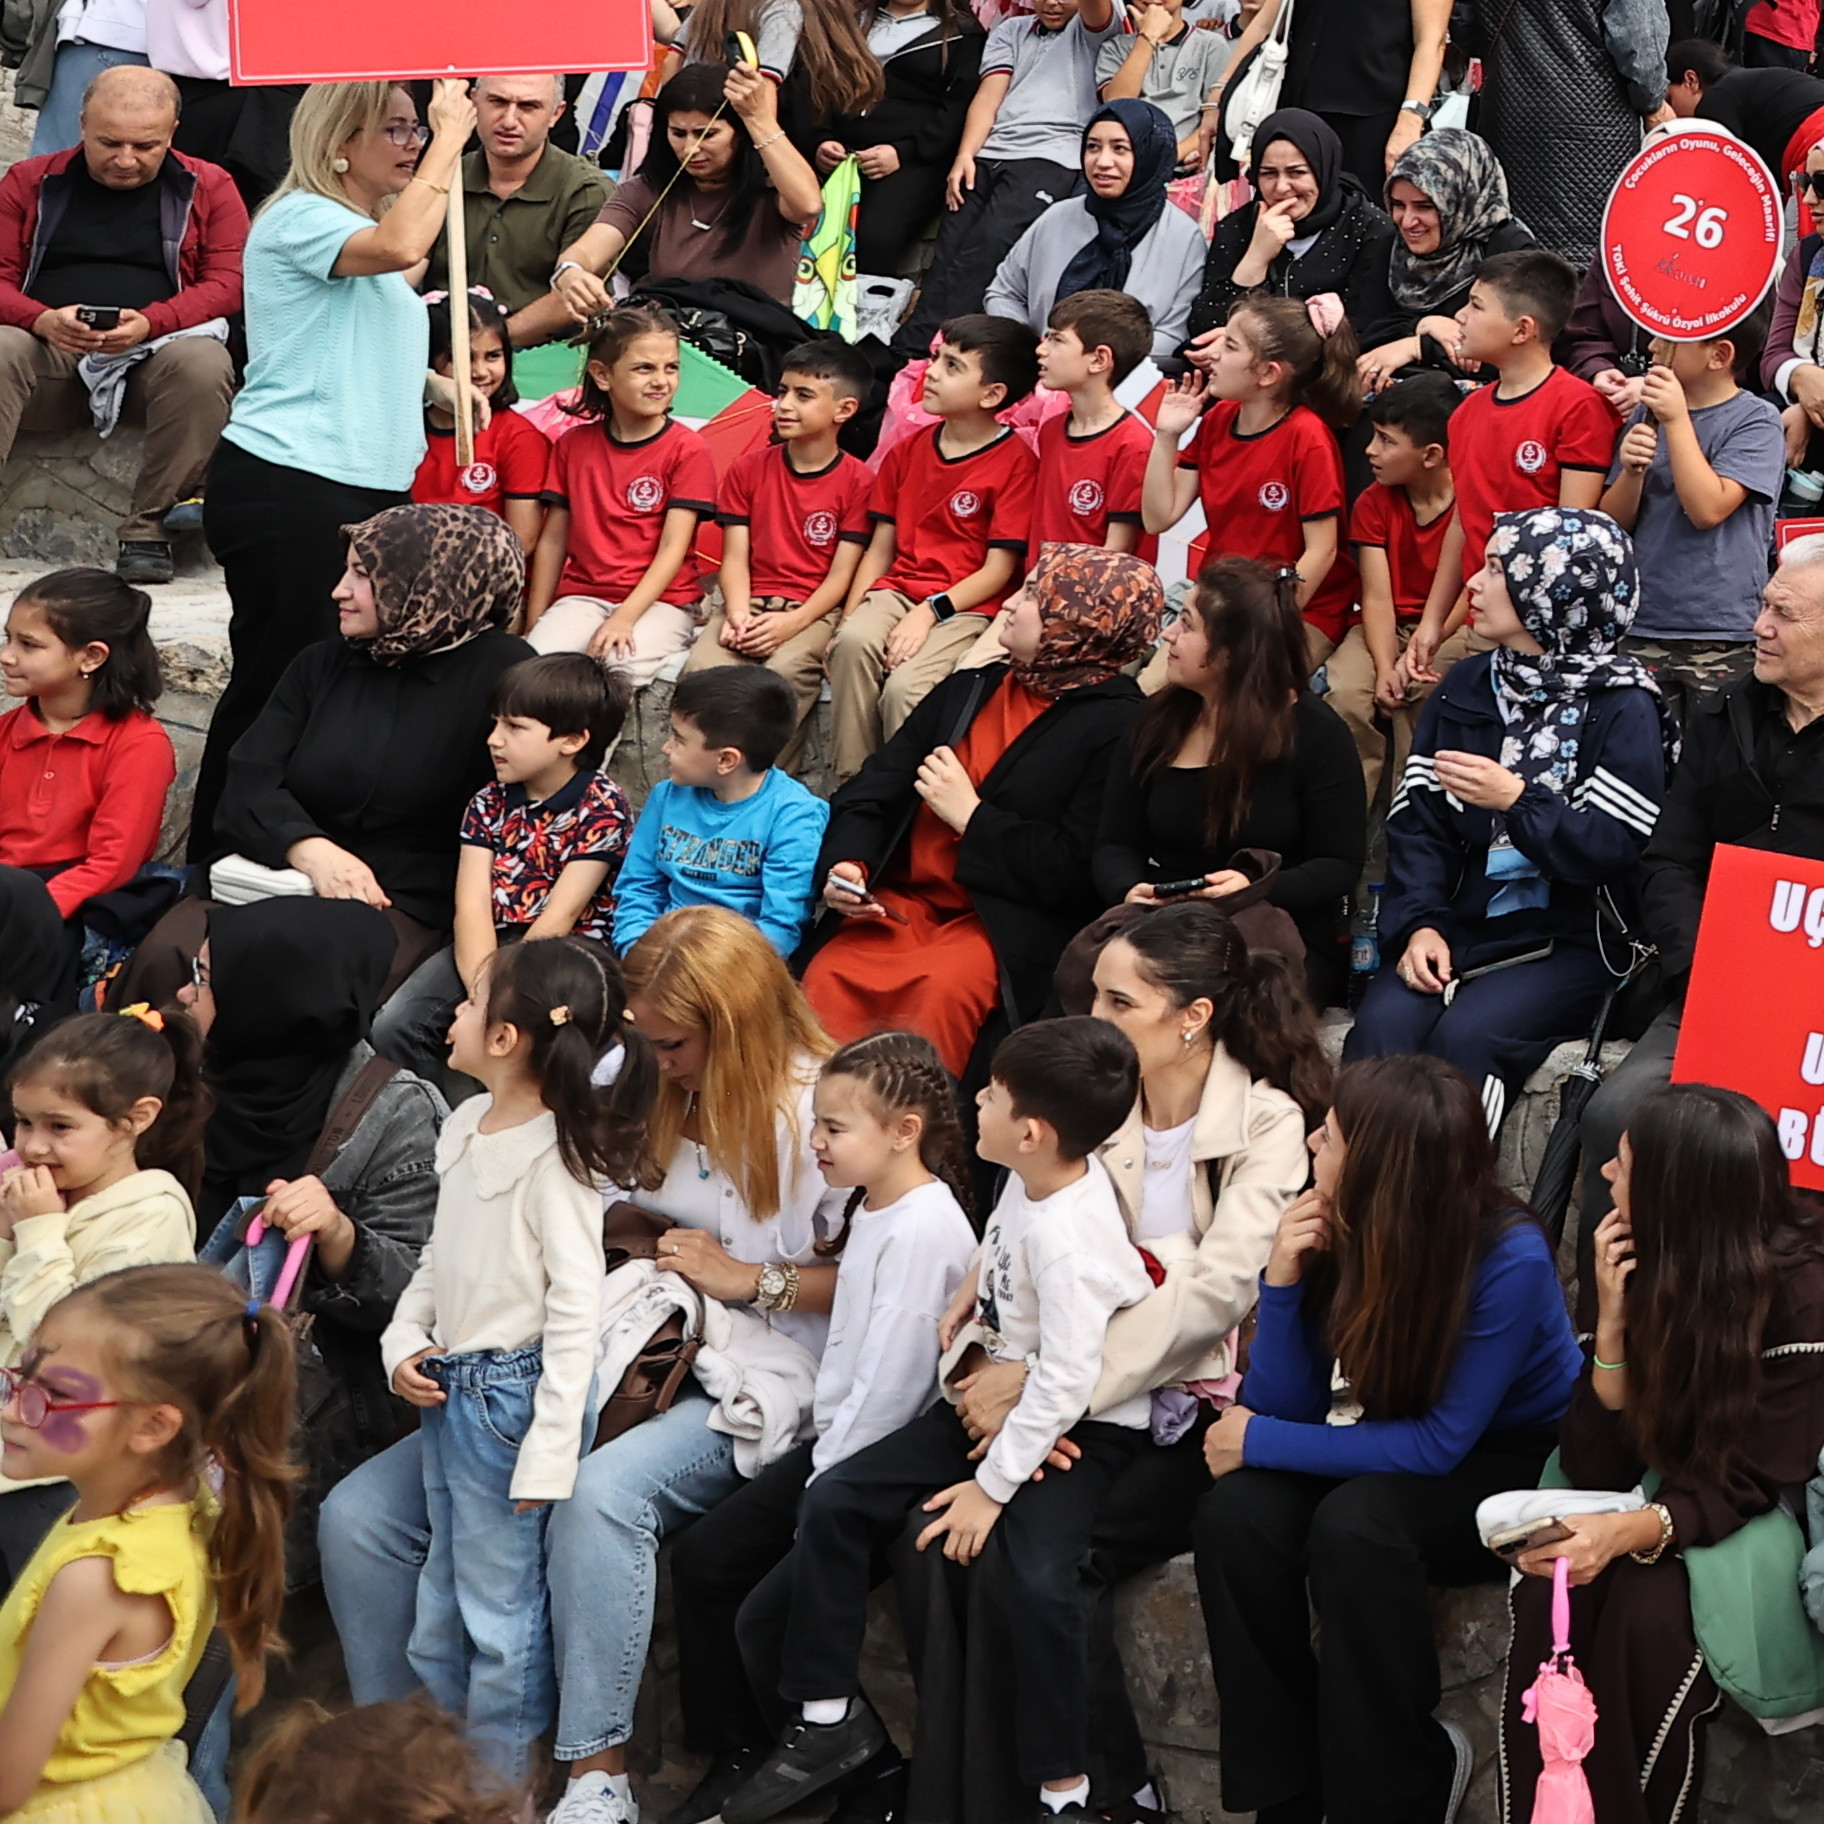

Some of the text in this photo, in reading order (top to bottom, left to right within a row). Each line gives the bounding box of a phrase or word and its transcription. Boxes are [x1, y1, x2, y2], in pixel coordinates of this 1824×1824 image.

[1624, 138, 1776, 243] Çocukların Oyunu, Geleceğin Maarifi
[1662, 194, 1729, 249] 26
[1611, 243, 1628, 276] TOKİ
[1618, 274, 1642, 307] Şehit
[1640, 300, 1670, 326] Şükrü
[1672, 314, 1704, 332] Özyol
[1704, 292, 1748, 326] İlkokulu
